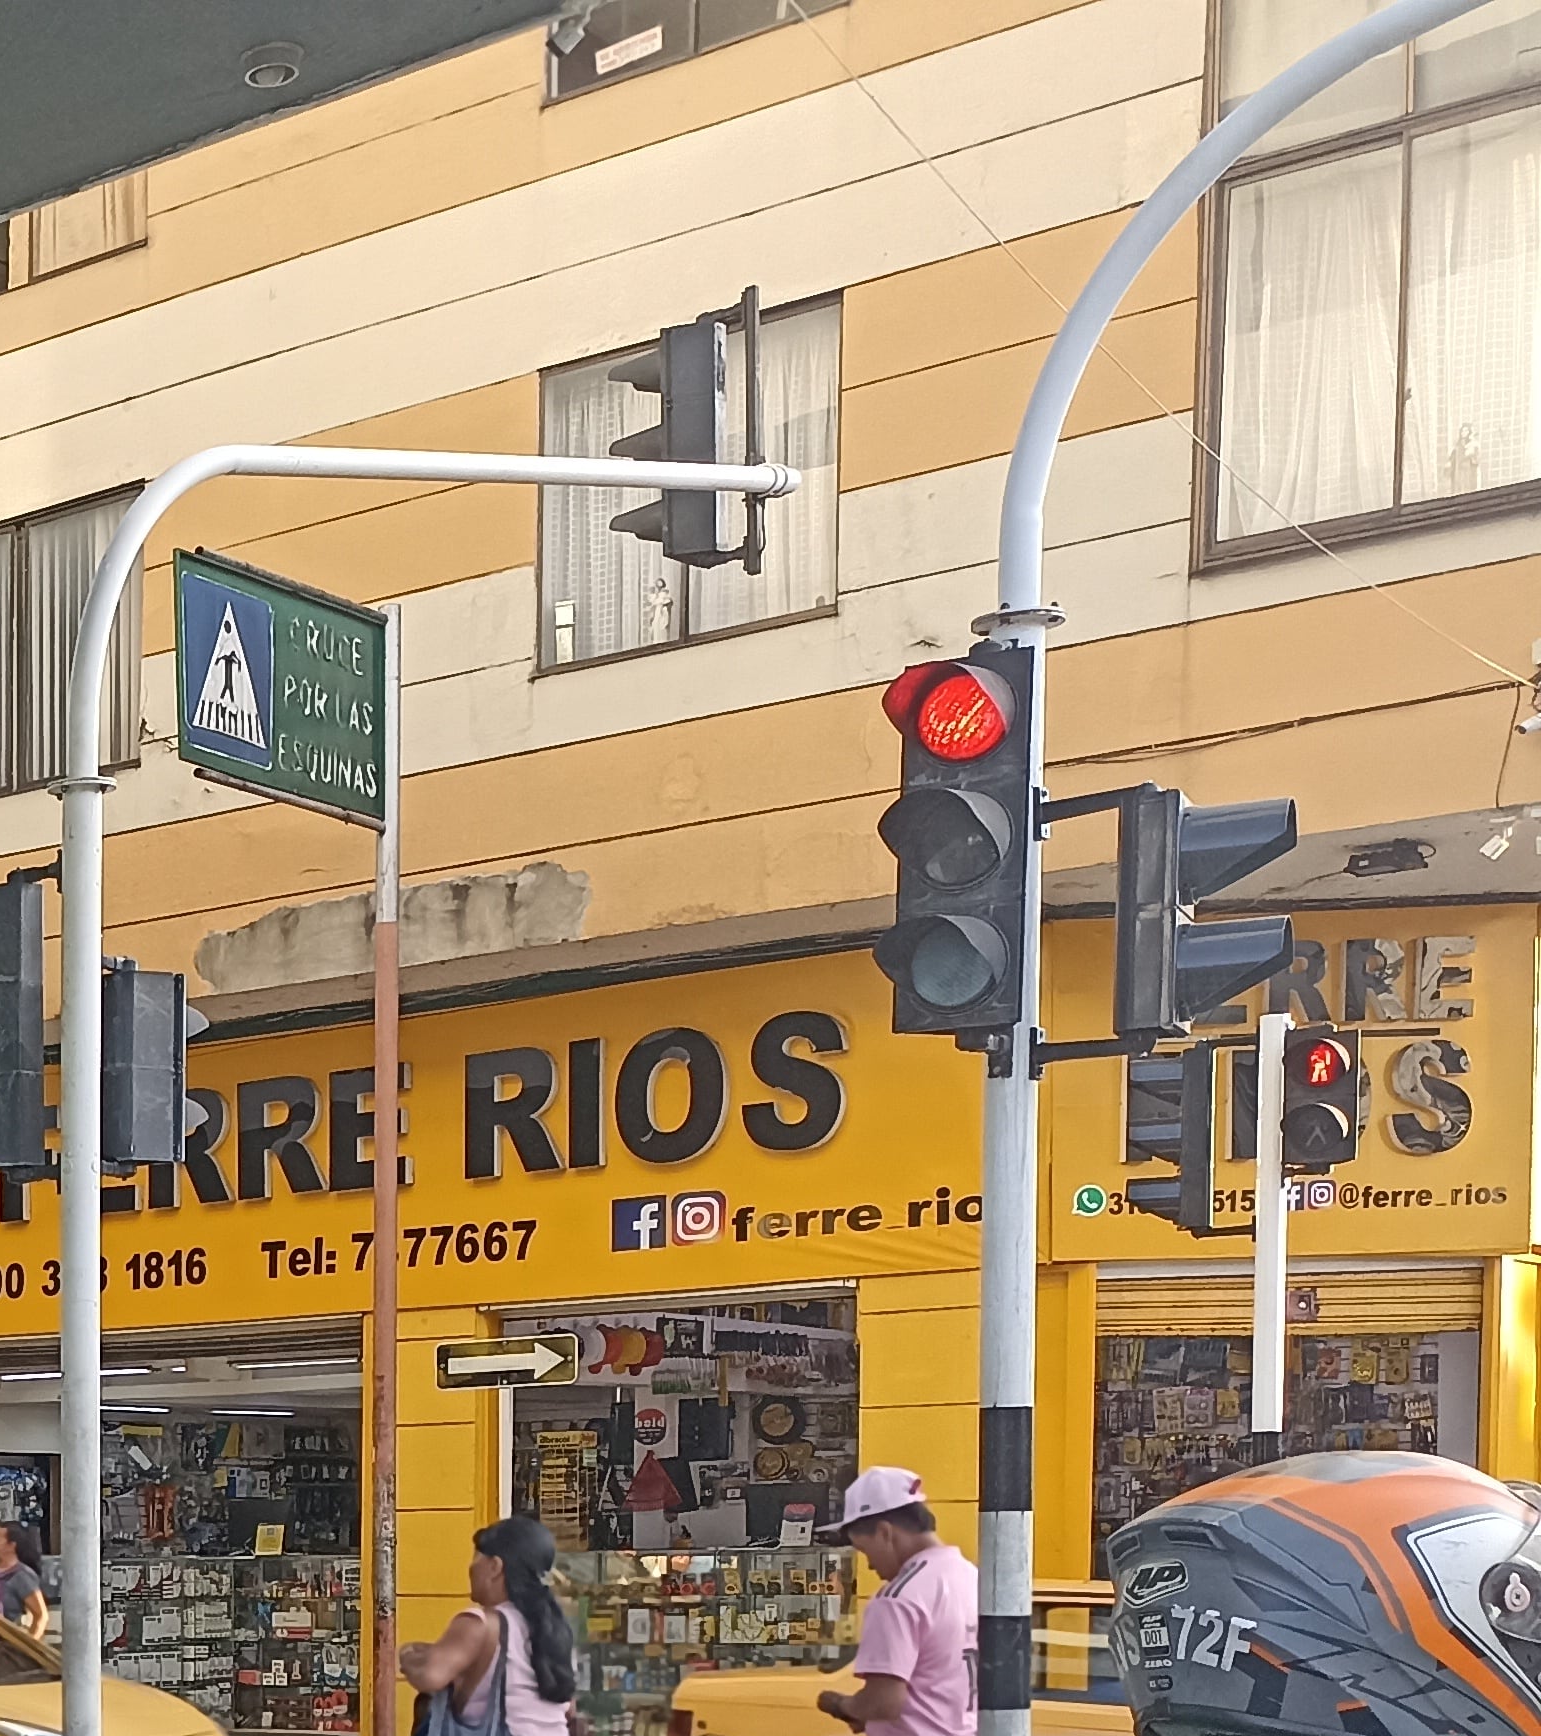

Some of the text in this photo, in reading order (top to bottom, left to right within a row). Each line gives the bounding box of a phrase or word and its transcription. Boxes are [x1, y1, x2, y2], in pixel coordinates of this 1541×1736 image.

[284, 674, 328, 719] POR
[278, 733, 378, 799] ESQUINAS
[463, 1010, 850, 1183] RIOS
[1338, 1182, 1508, 1210] @ferre_rios
[125, 1247, 208, 1291] 1816
[261, 1237, 337, 1280] Tel:
[351, 1219, 538, 1273] 777667
[1170, 1603, 1258, 1673] 72F
